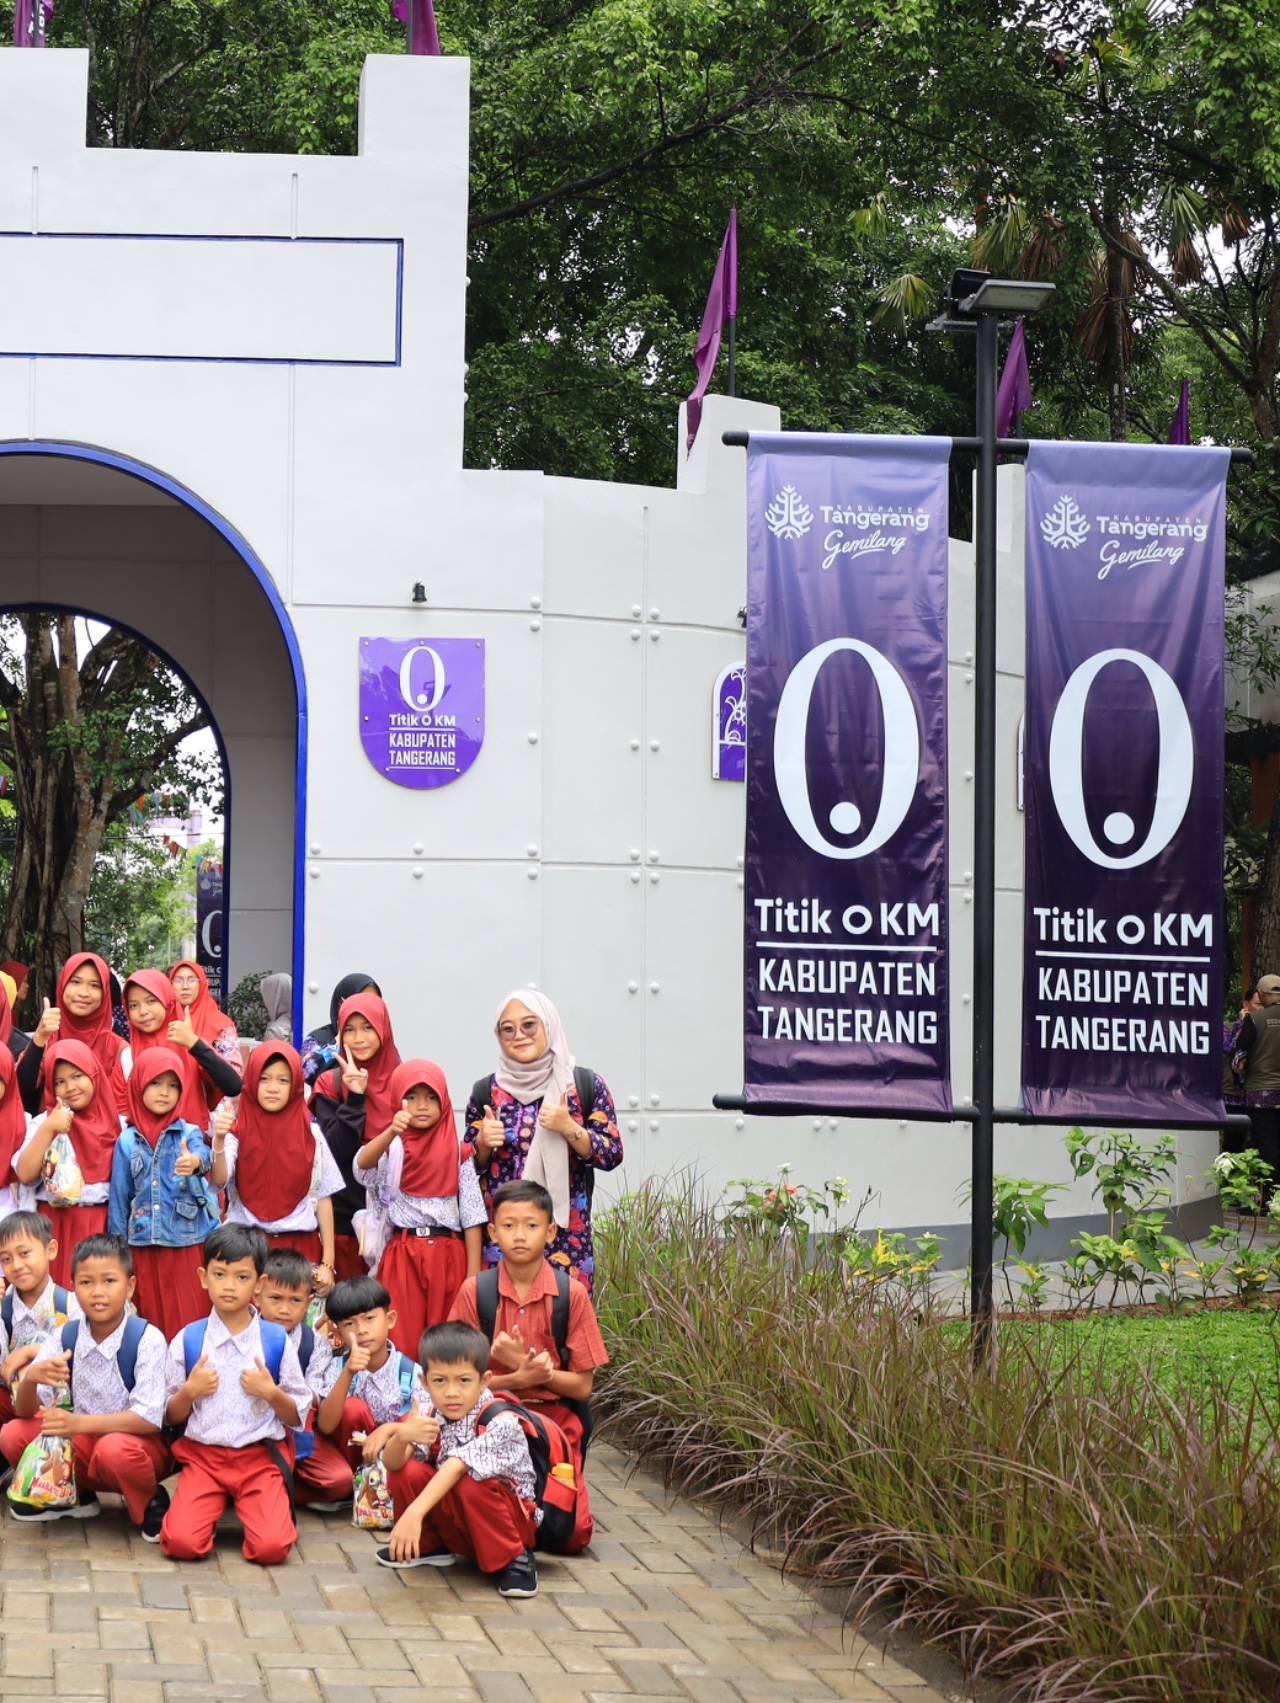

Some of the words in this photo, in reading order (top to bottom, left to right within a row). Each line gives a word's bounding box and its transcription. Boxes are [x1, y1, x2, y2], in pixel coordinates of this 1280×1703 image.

[819, 505, 931, 531] Tangerang
[836, 504, 925, 514] KABUPATEN
[1113, 514, 1202, 524] KABUPATEN
[1096, 516, 1209, 542] Tangerang
[821, 529, 907, 570] Gemilang
[1097, 540, 1185, 580] Gemilang
[389, 713, 419, 726] Titik
[435, 715, 456, 727] KM
[388, 750, 456, 766] TANGERANG
[389, 733, 456, 748] KABUPATEN
[755, 898, 832, 934] Titik
[881, 903, 940, 936] KM
[1034, 907, 1107, 944] Titik
[1154, 913, 1213, 947] KM
[759, 959, 935, 996] KABUPATEN
[1038, 966, 1208, 1007] KABUPATEN
[757, 1006, 937, 1044] TANGERANG
[1035, 1014, 1210, 1055] TANGERANG
